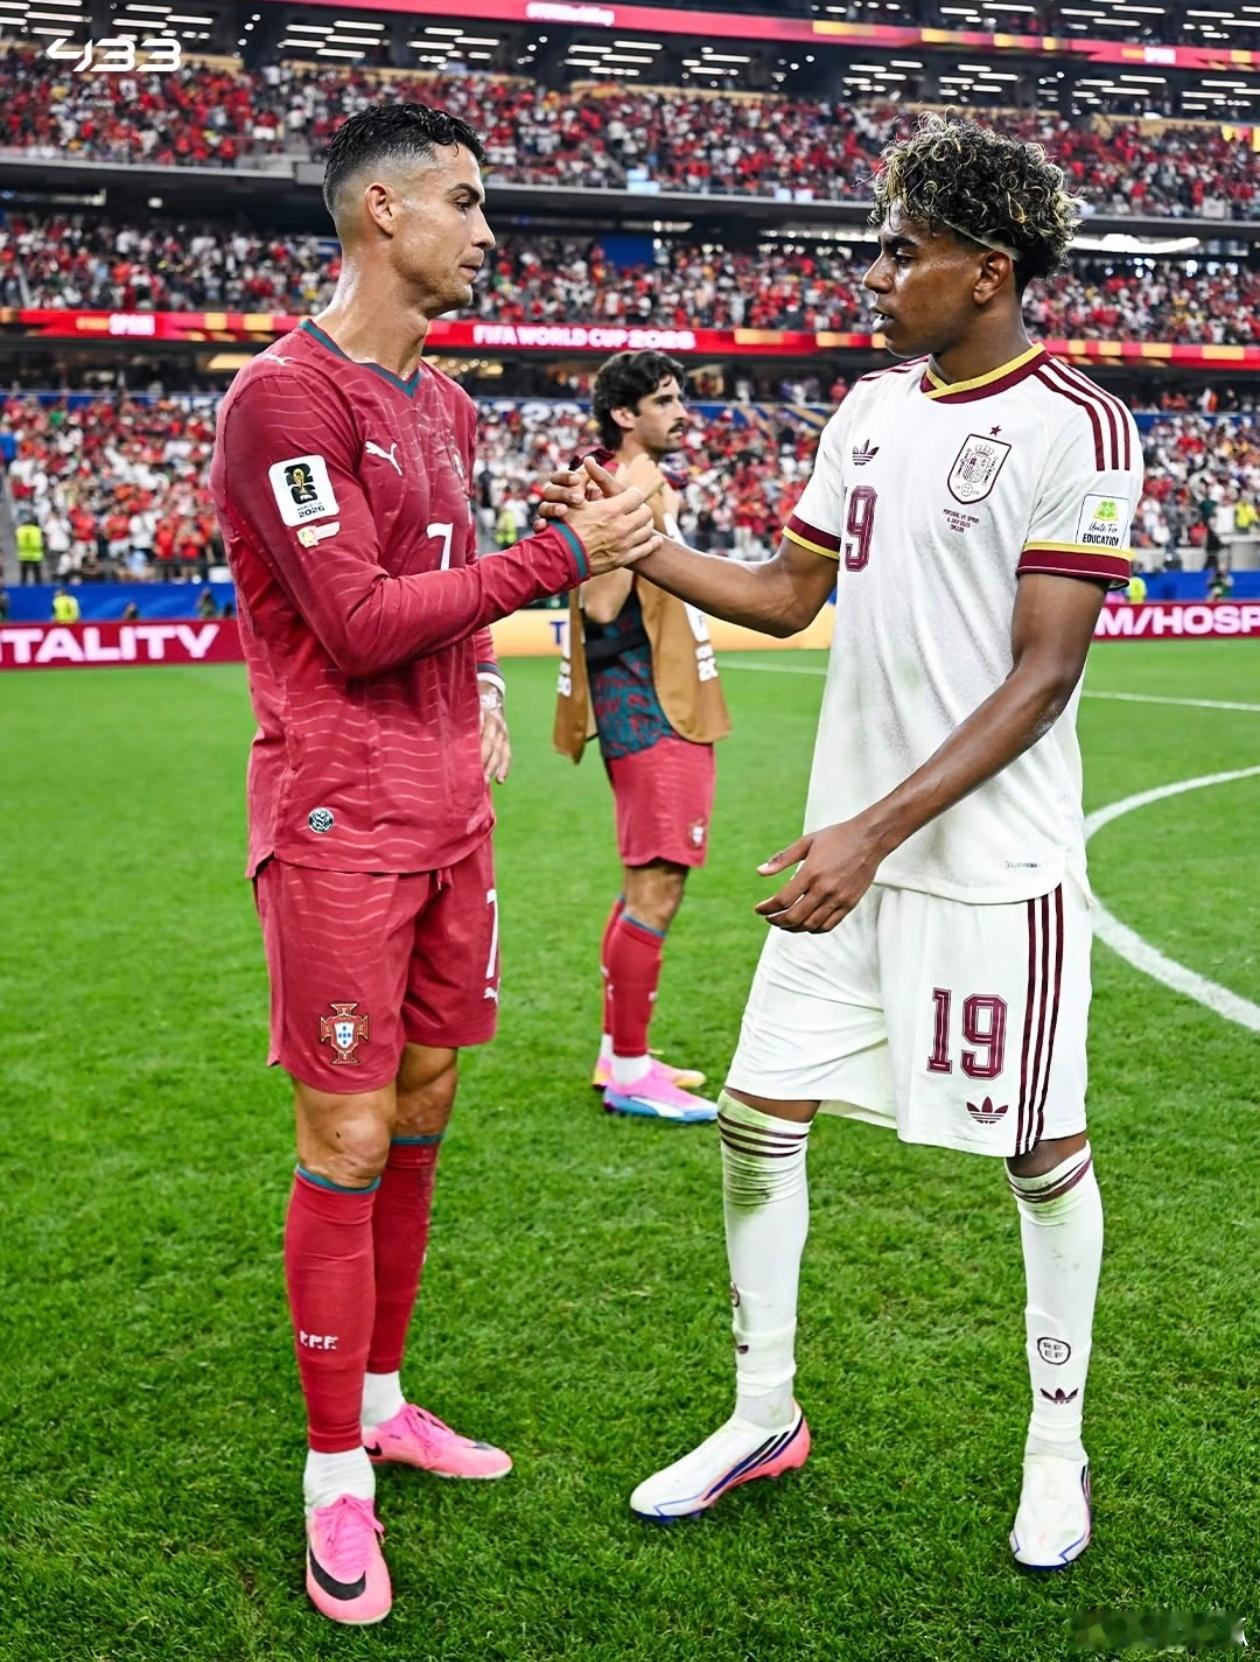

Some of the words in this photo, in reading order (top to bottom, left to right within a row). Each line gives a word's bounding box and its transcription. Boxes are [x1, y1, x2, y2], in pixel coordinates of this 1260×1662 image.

[473, 324, 517, 345] FIFA
[517, 326, 587, 347] WORLD
[588, 328, 627, 348] CUP
[298, 505, 325, 518] 2026
[843, 485, 878, 573] 9
[426, 522, 454, 572] 7
[0, 624, 220, 664] TALITY
[926, 987, 1008, 1081] 19
